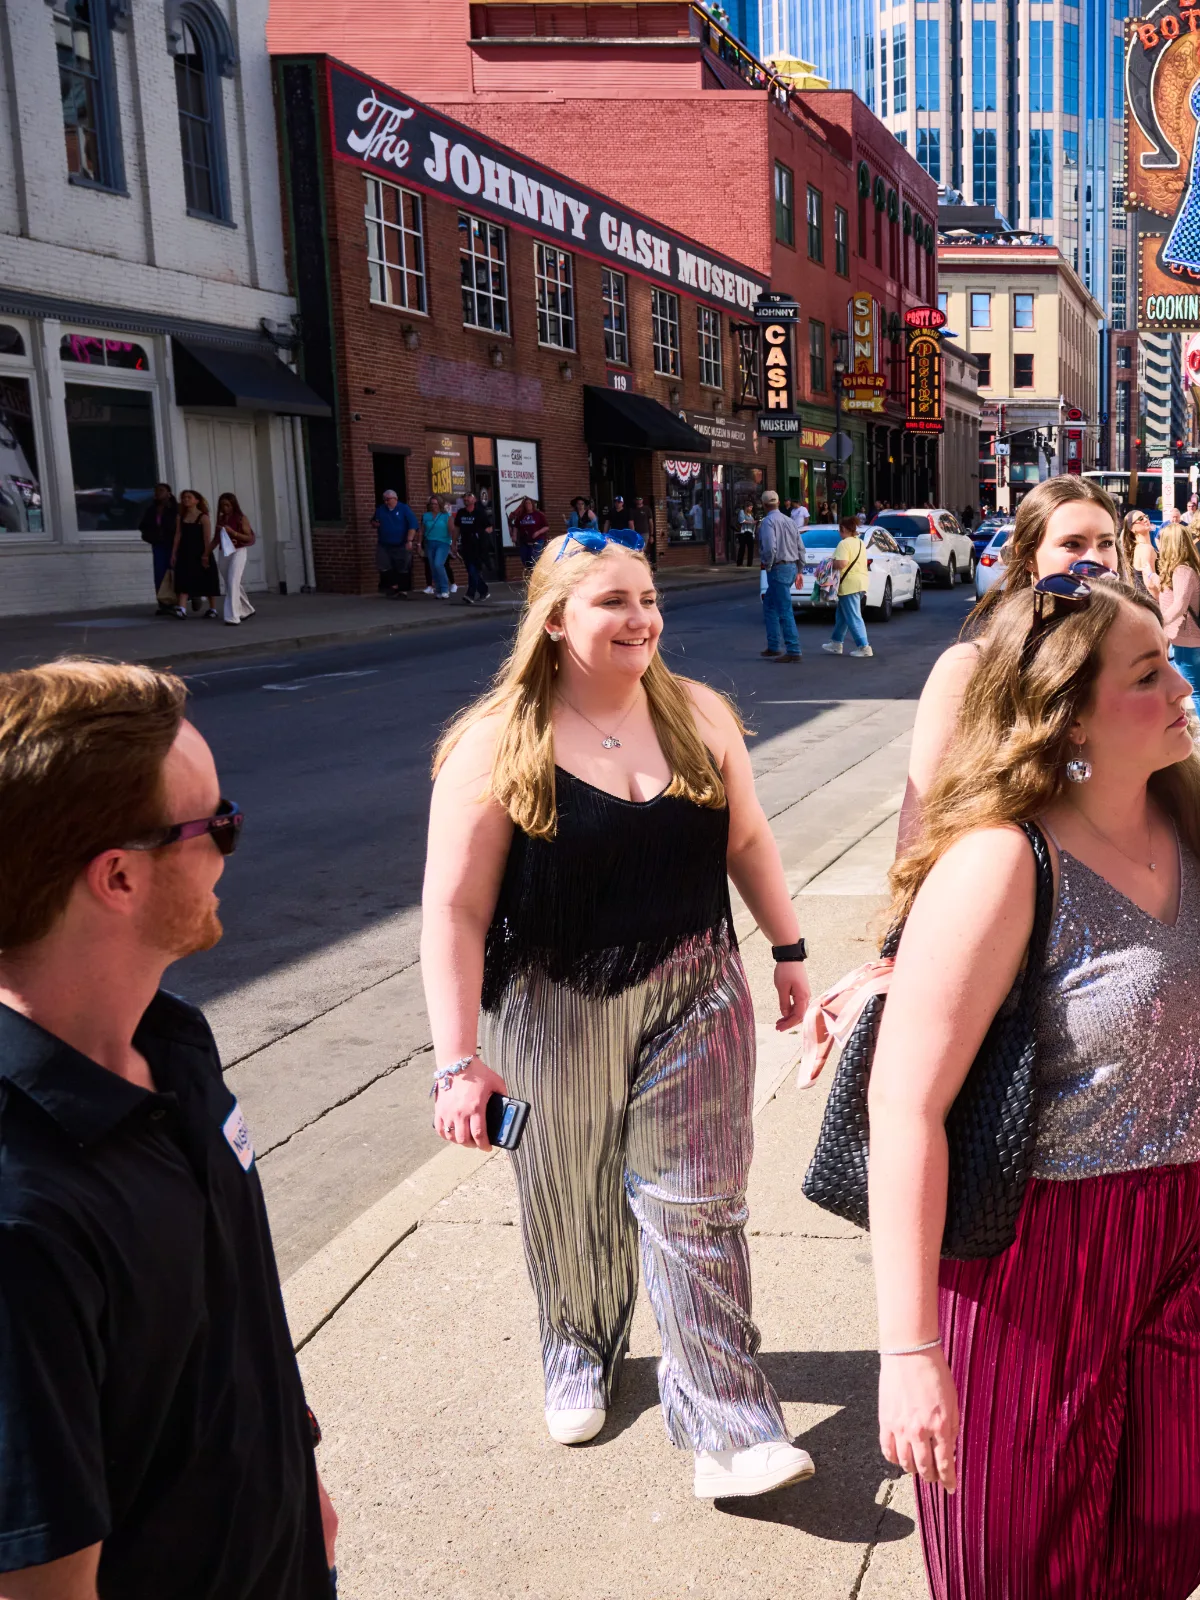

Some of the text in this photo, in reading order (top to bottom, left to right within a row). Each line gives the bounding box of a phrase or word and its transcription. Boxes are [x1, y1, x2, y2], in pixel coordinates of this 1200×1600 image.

[346, 89, 763, 312] The JOHNNY CASH MUSEUM
[756, 308, 795, 317] JOHNNY
[906, 310, 930, 326] POSTY
[855, 299, 871, 358] SUN
[910, 328, 940, 339] LIVE MUSIC
[765, 324, 788, 409] CASH
[613, 375, 627, 391] 119
[843, 376, 885, 387] DINER
[848, 400, 875, 408] OPEN
[699, 425, 711, 435] MUSIC
[711, 426, 726, 438] MUSEUM
[731, 430, 746, 441] AMERICA
[760, 419, 798, 432] MUSEUM
[432, 467, 452, 494] CASH
[513, 471, 535, 480] EXPANDING
